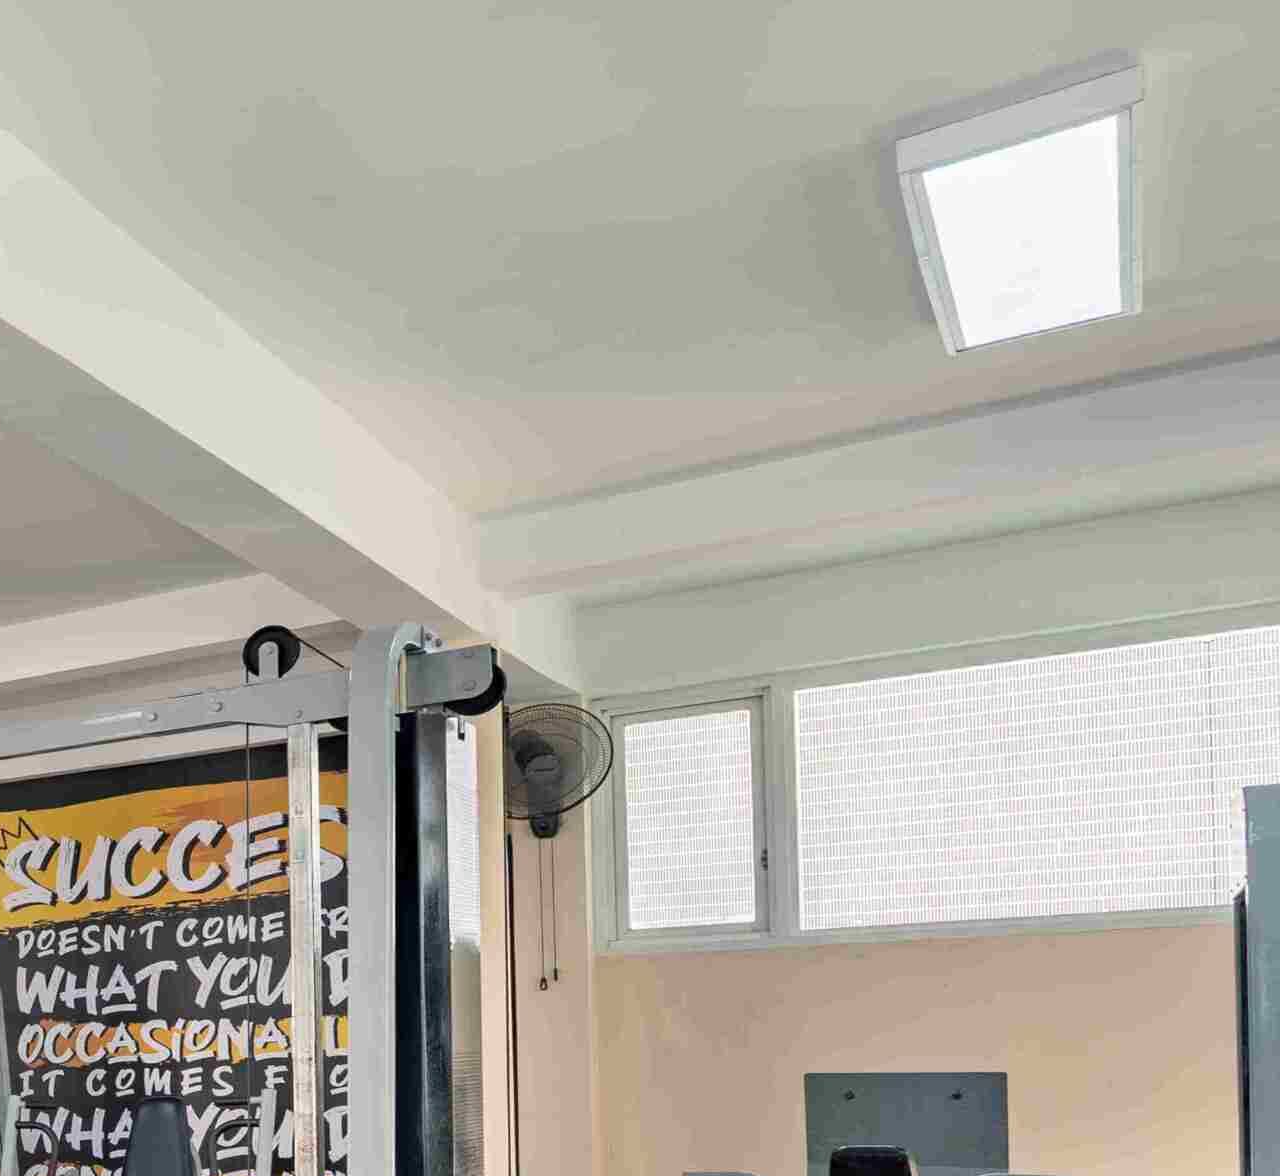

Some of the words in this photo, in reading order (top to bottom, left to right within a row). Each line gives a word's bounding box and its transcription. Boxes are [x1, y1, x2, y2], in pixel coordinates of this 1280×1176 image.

[2, 805, 349, 912] SUCCES
[16, 919, 165, 959] DOESN'T
[175, 911, 286, 948] COME
[16, 959, 179, 1015] WHAT
[186, 951, 292, 1010] YOU
[17, 1016, 349, 1064] OCCASIONAL
[19, 1069, 65, 1098] IT
[85, 1064, 235, 1097] COMES
[20, 1106, 133, 1159] WHA
